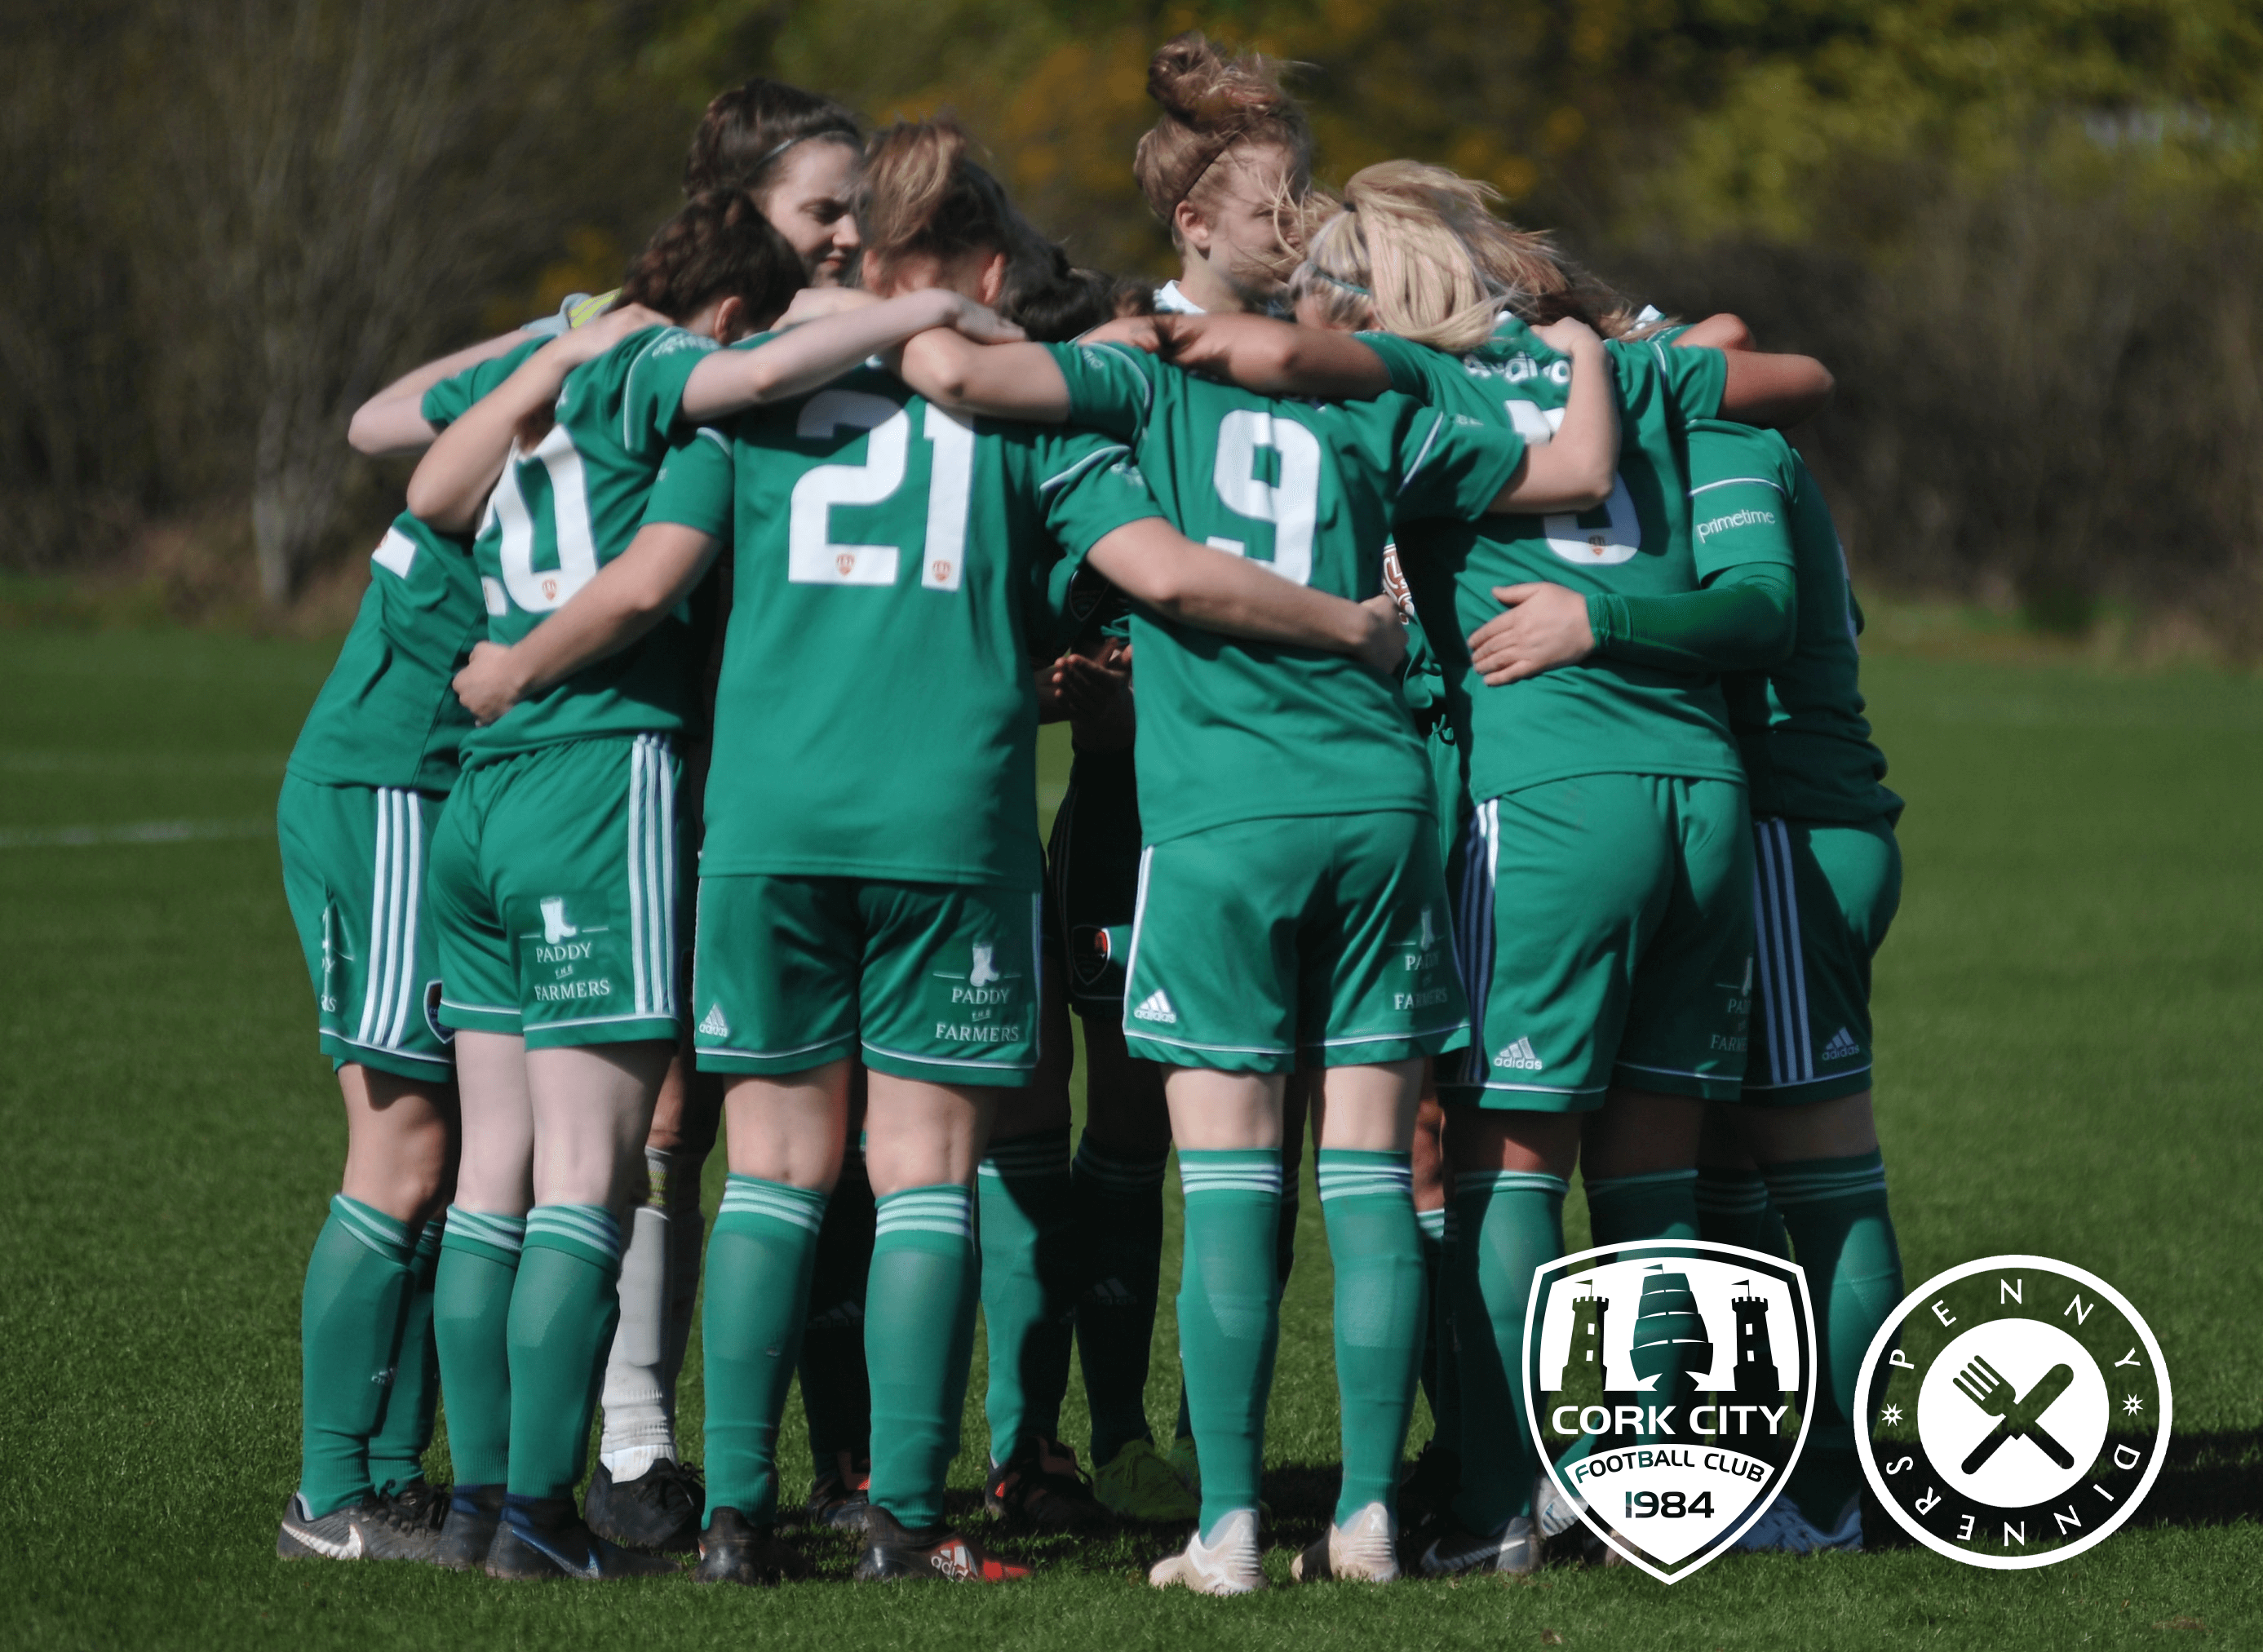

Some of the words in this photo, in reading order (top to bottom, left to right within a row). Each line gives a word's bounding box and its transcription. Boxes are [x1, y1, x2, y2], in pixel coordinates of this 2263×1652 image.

[788, 390, 976, 591] 21
[1206, 409, 1321, 587] 9
[476, 423, 597, 616] 0
[1697, 509, 1775, 544] primetime
[536, 942, 591, 963] PADDY
[534, 979, 610, 1001] FARMERS
[951, 988, 1010, 1004] PADDY
[1134, 1009, 1176, 1024] adidas
[699, 1022, 728, 1037] adidas
[936, 1023, 1019, 1042] FARMERS
[1822, 1044, 1859, 1061] adidas
[1494, 1057, 1543, 1070] adidas
